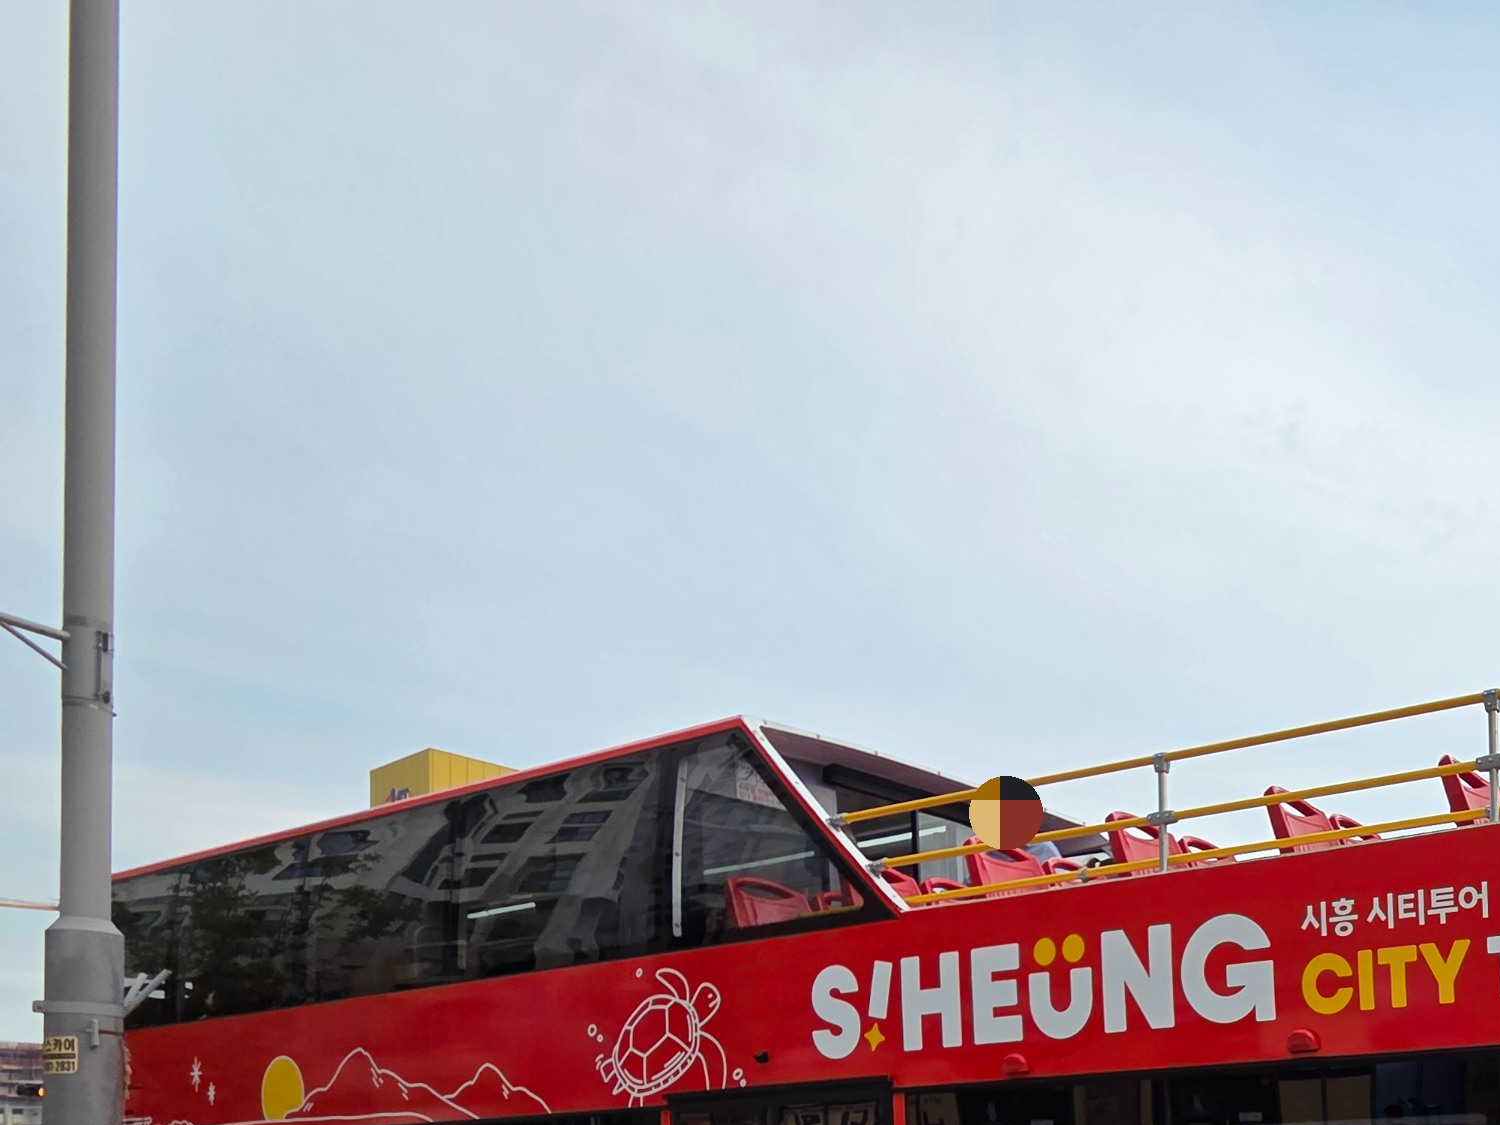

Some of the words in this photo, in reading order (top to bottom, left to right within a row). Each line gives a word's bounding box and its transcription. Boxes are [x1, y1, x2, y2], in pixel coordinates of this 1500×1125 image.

[1301, 898, 1358, 937] 시흥
[1367, 881, 1489, 929] 시티투어
[1301, 938, 1471, 1015] CITY
